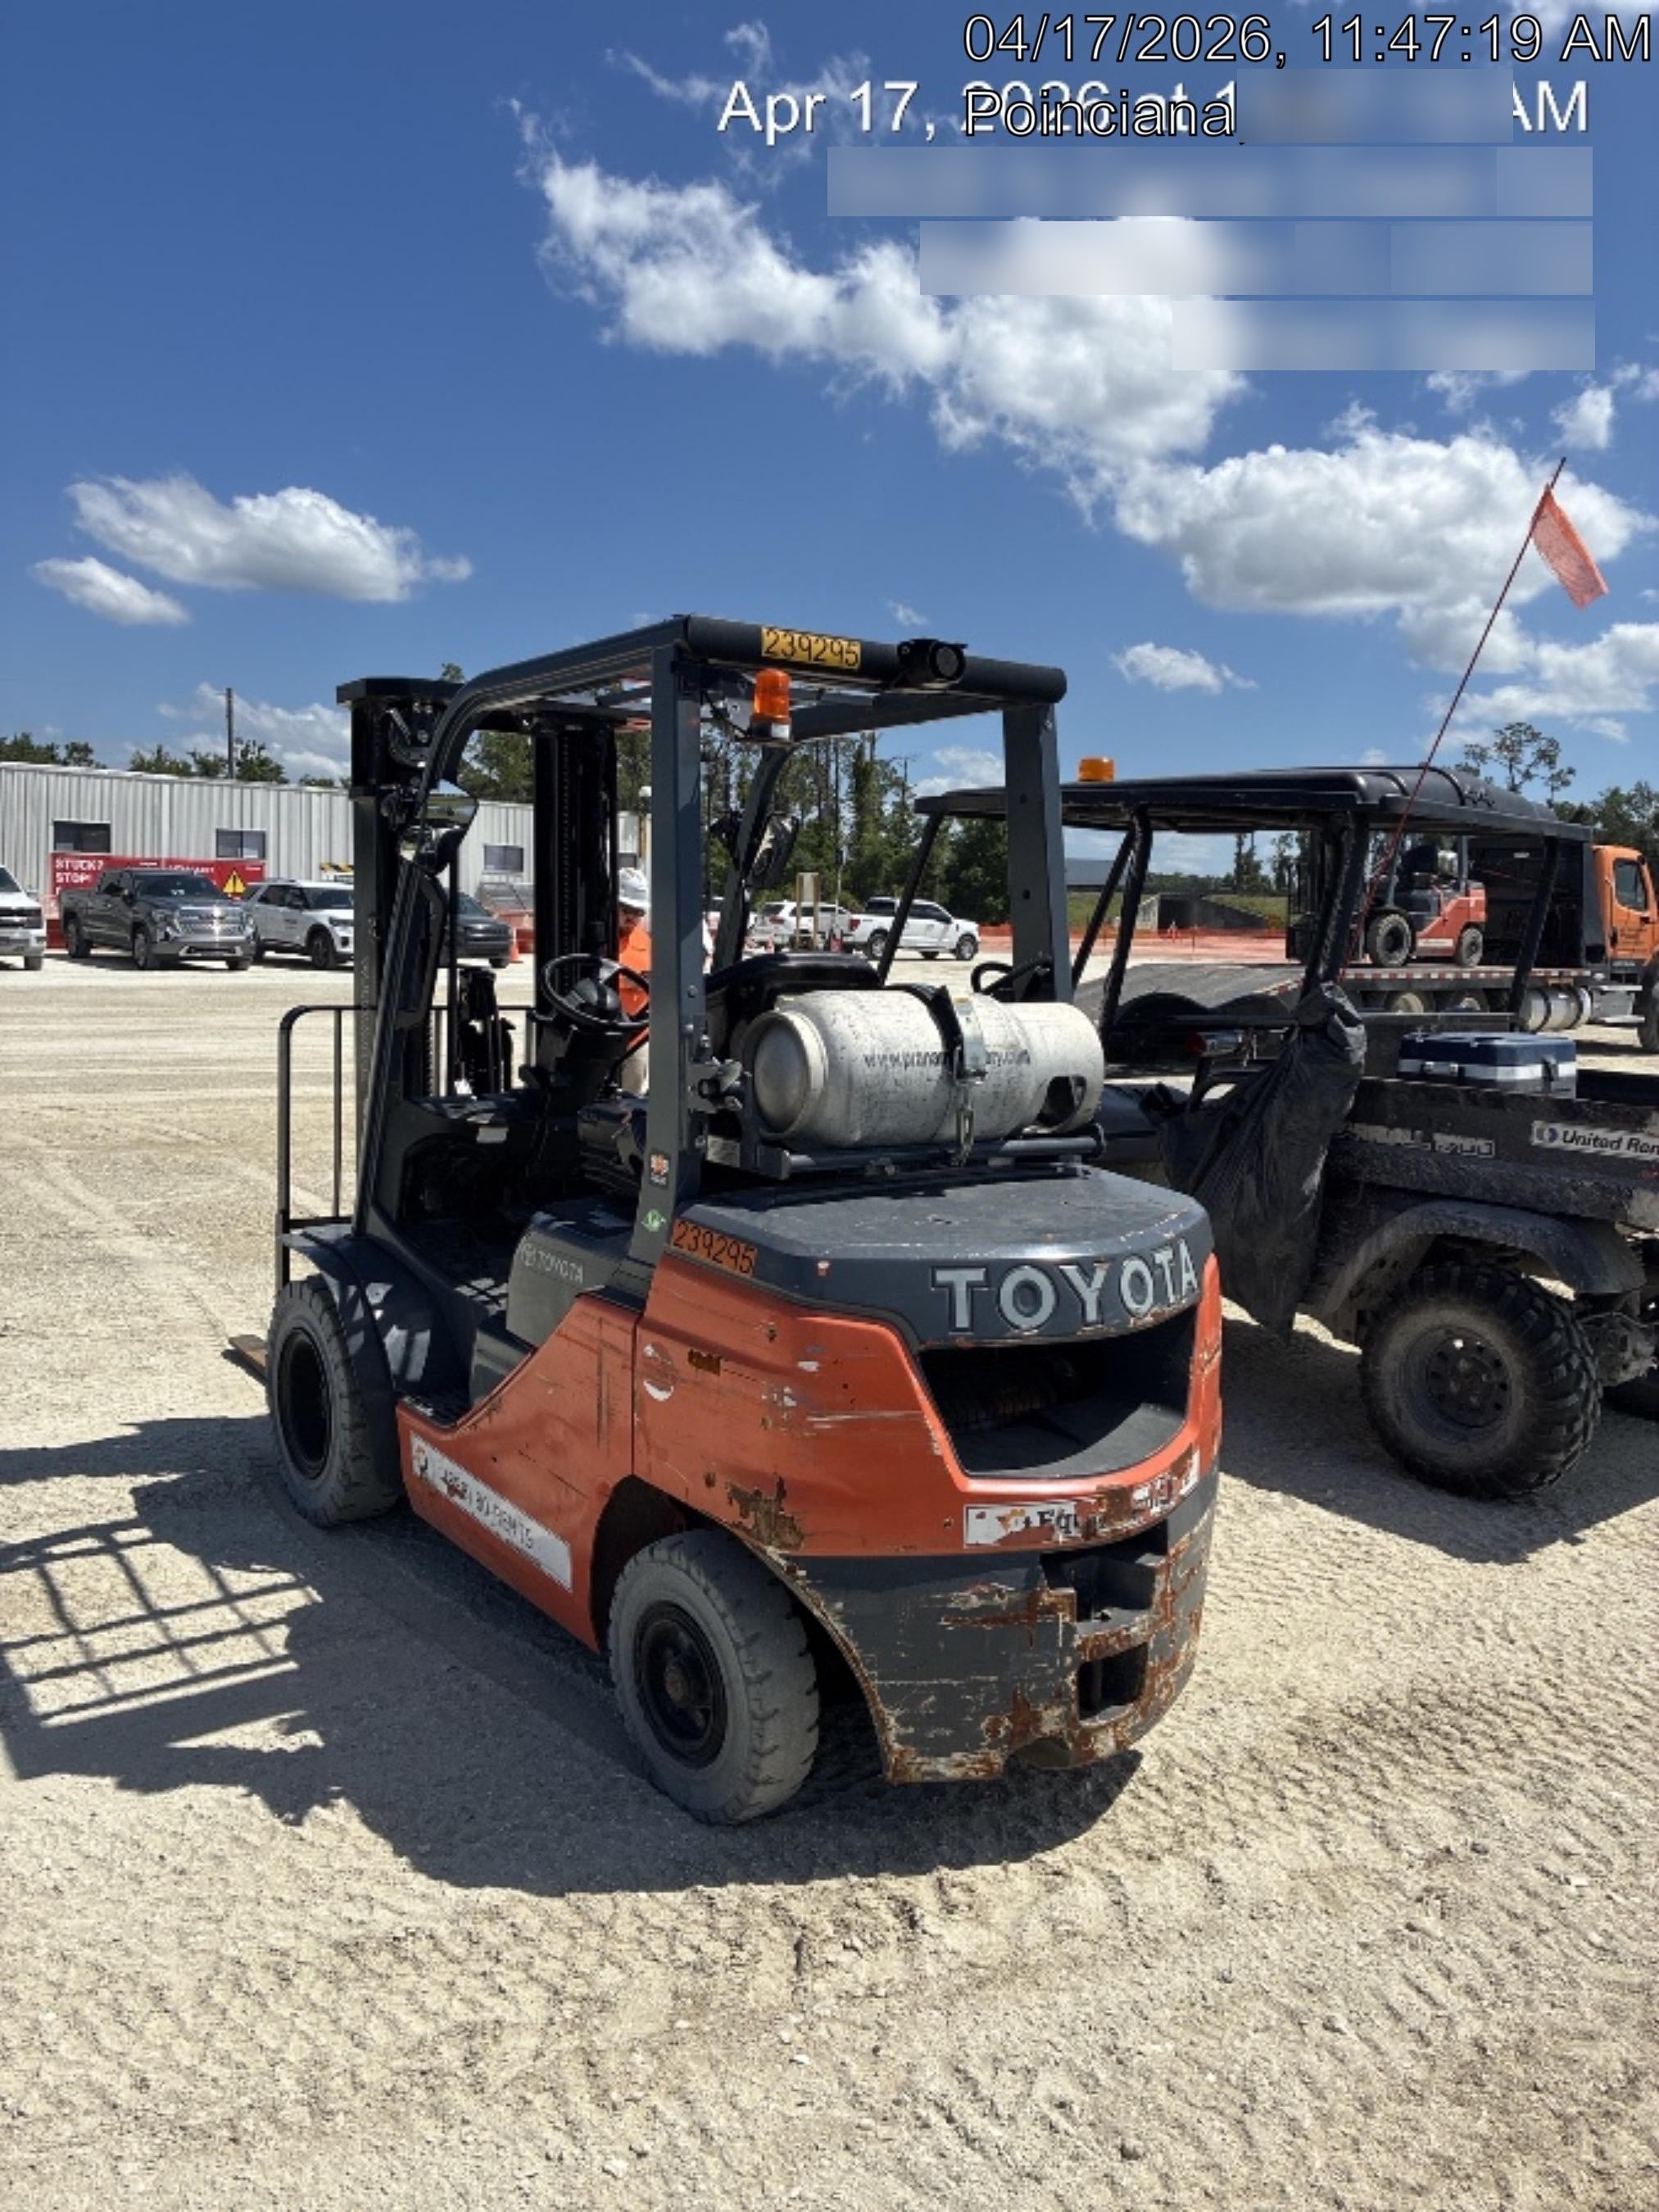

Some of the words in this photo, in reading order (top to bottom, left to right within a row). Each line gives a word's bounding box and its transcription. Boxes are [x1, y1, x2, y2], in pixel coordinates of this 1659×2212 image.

[765, 628, 859, 667] 239295
[55, 859, 104, 871] STUCK?
[1562, 1130, 1623, 1150] United
[673, 1220, 755, 1274] 239295
[934, 1239, 1199, 1332] TOYOTA
